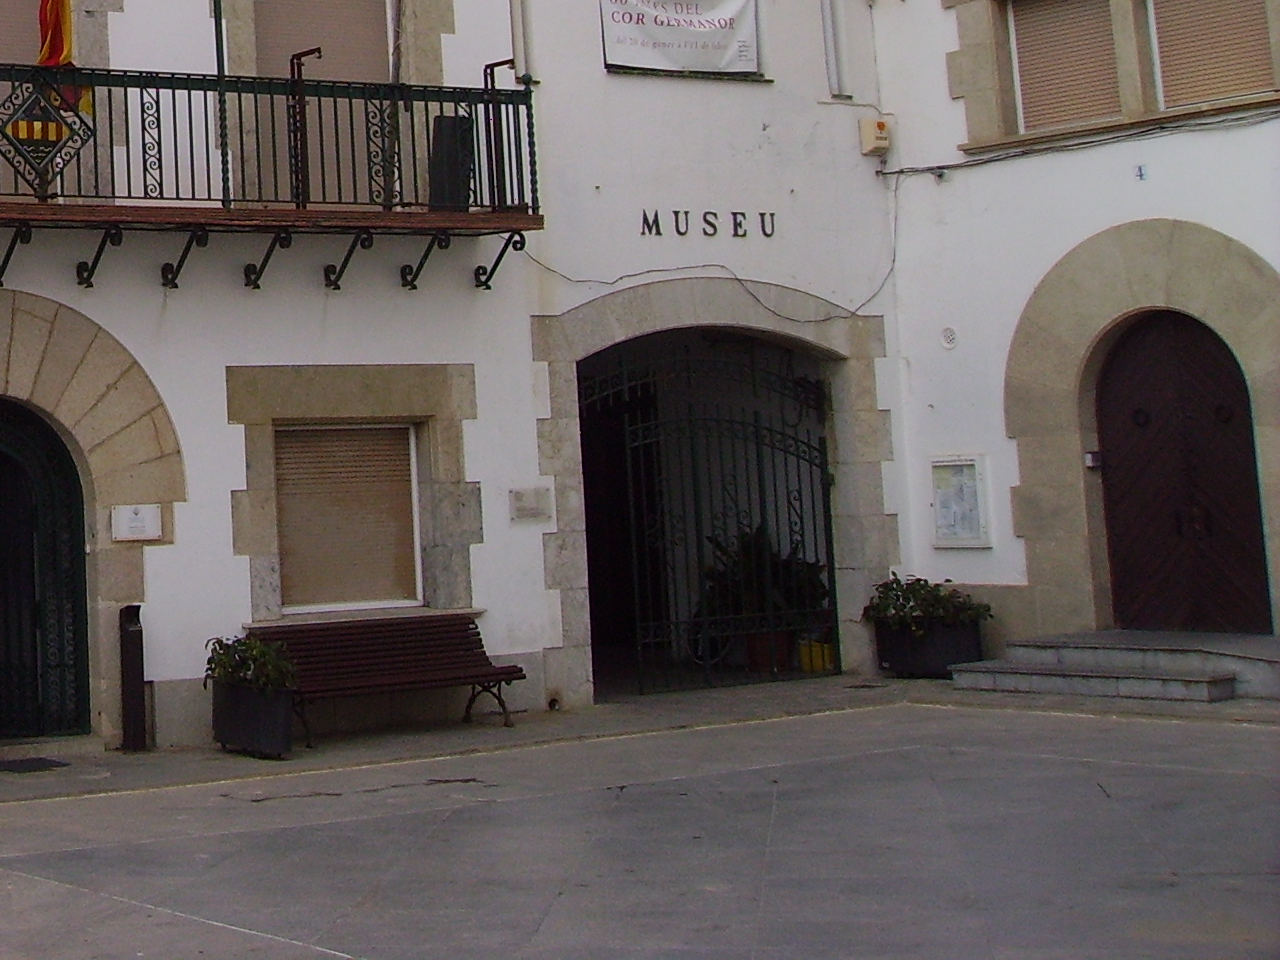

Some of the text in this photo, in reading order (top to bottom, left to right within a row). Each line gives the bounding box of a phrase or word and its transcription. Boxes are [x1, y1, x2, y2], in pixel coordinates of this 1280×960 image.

[674, 2, 703, 16] DEL
[611, 10, 646, 26] COR
[1135, 165, 1146, 181] 4
[640, 209, 775, 238] MUSEU
